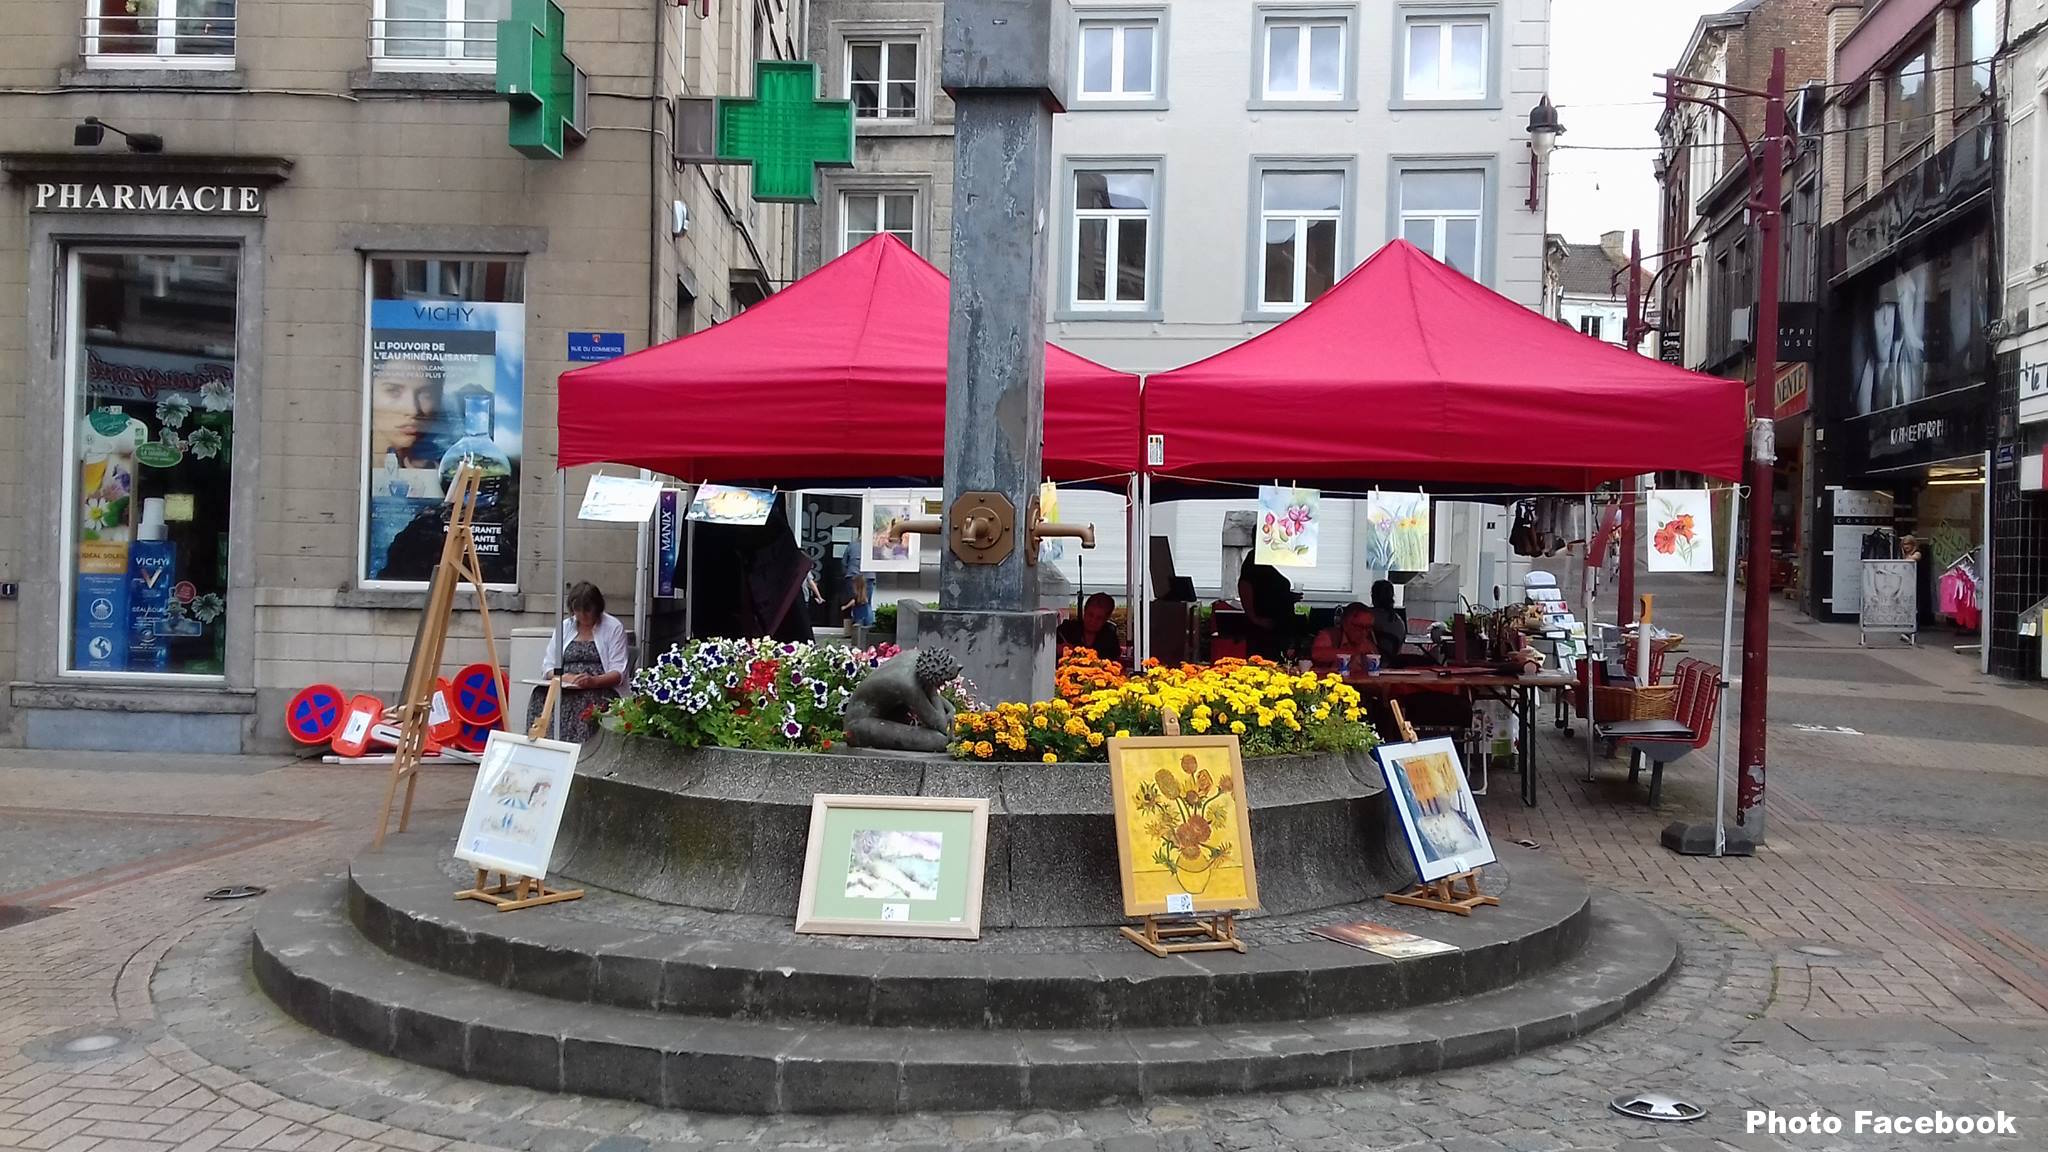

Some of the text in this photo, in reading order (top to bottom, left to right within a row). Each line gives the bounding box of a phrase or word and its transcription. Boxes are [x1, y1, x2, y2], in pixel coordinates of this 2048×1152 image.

[36, 183, 261, 213] PHARMACIE
[413, 306, 475, 323] VICHY
[1779, 327, 1813, 336] EPRI
[373, 341, 446, 351] LE POUVOIR DE
[373, 352, 479, 362] L'EAU MINÉRALISANTE
[661, 507, 673, 551] MANIX
[135, 557, 168, 566] VICHY
